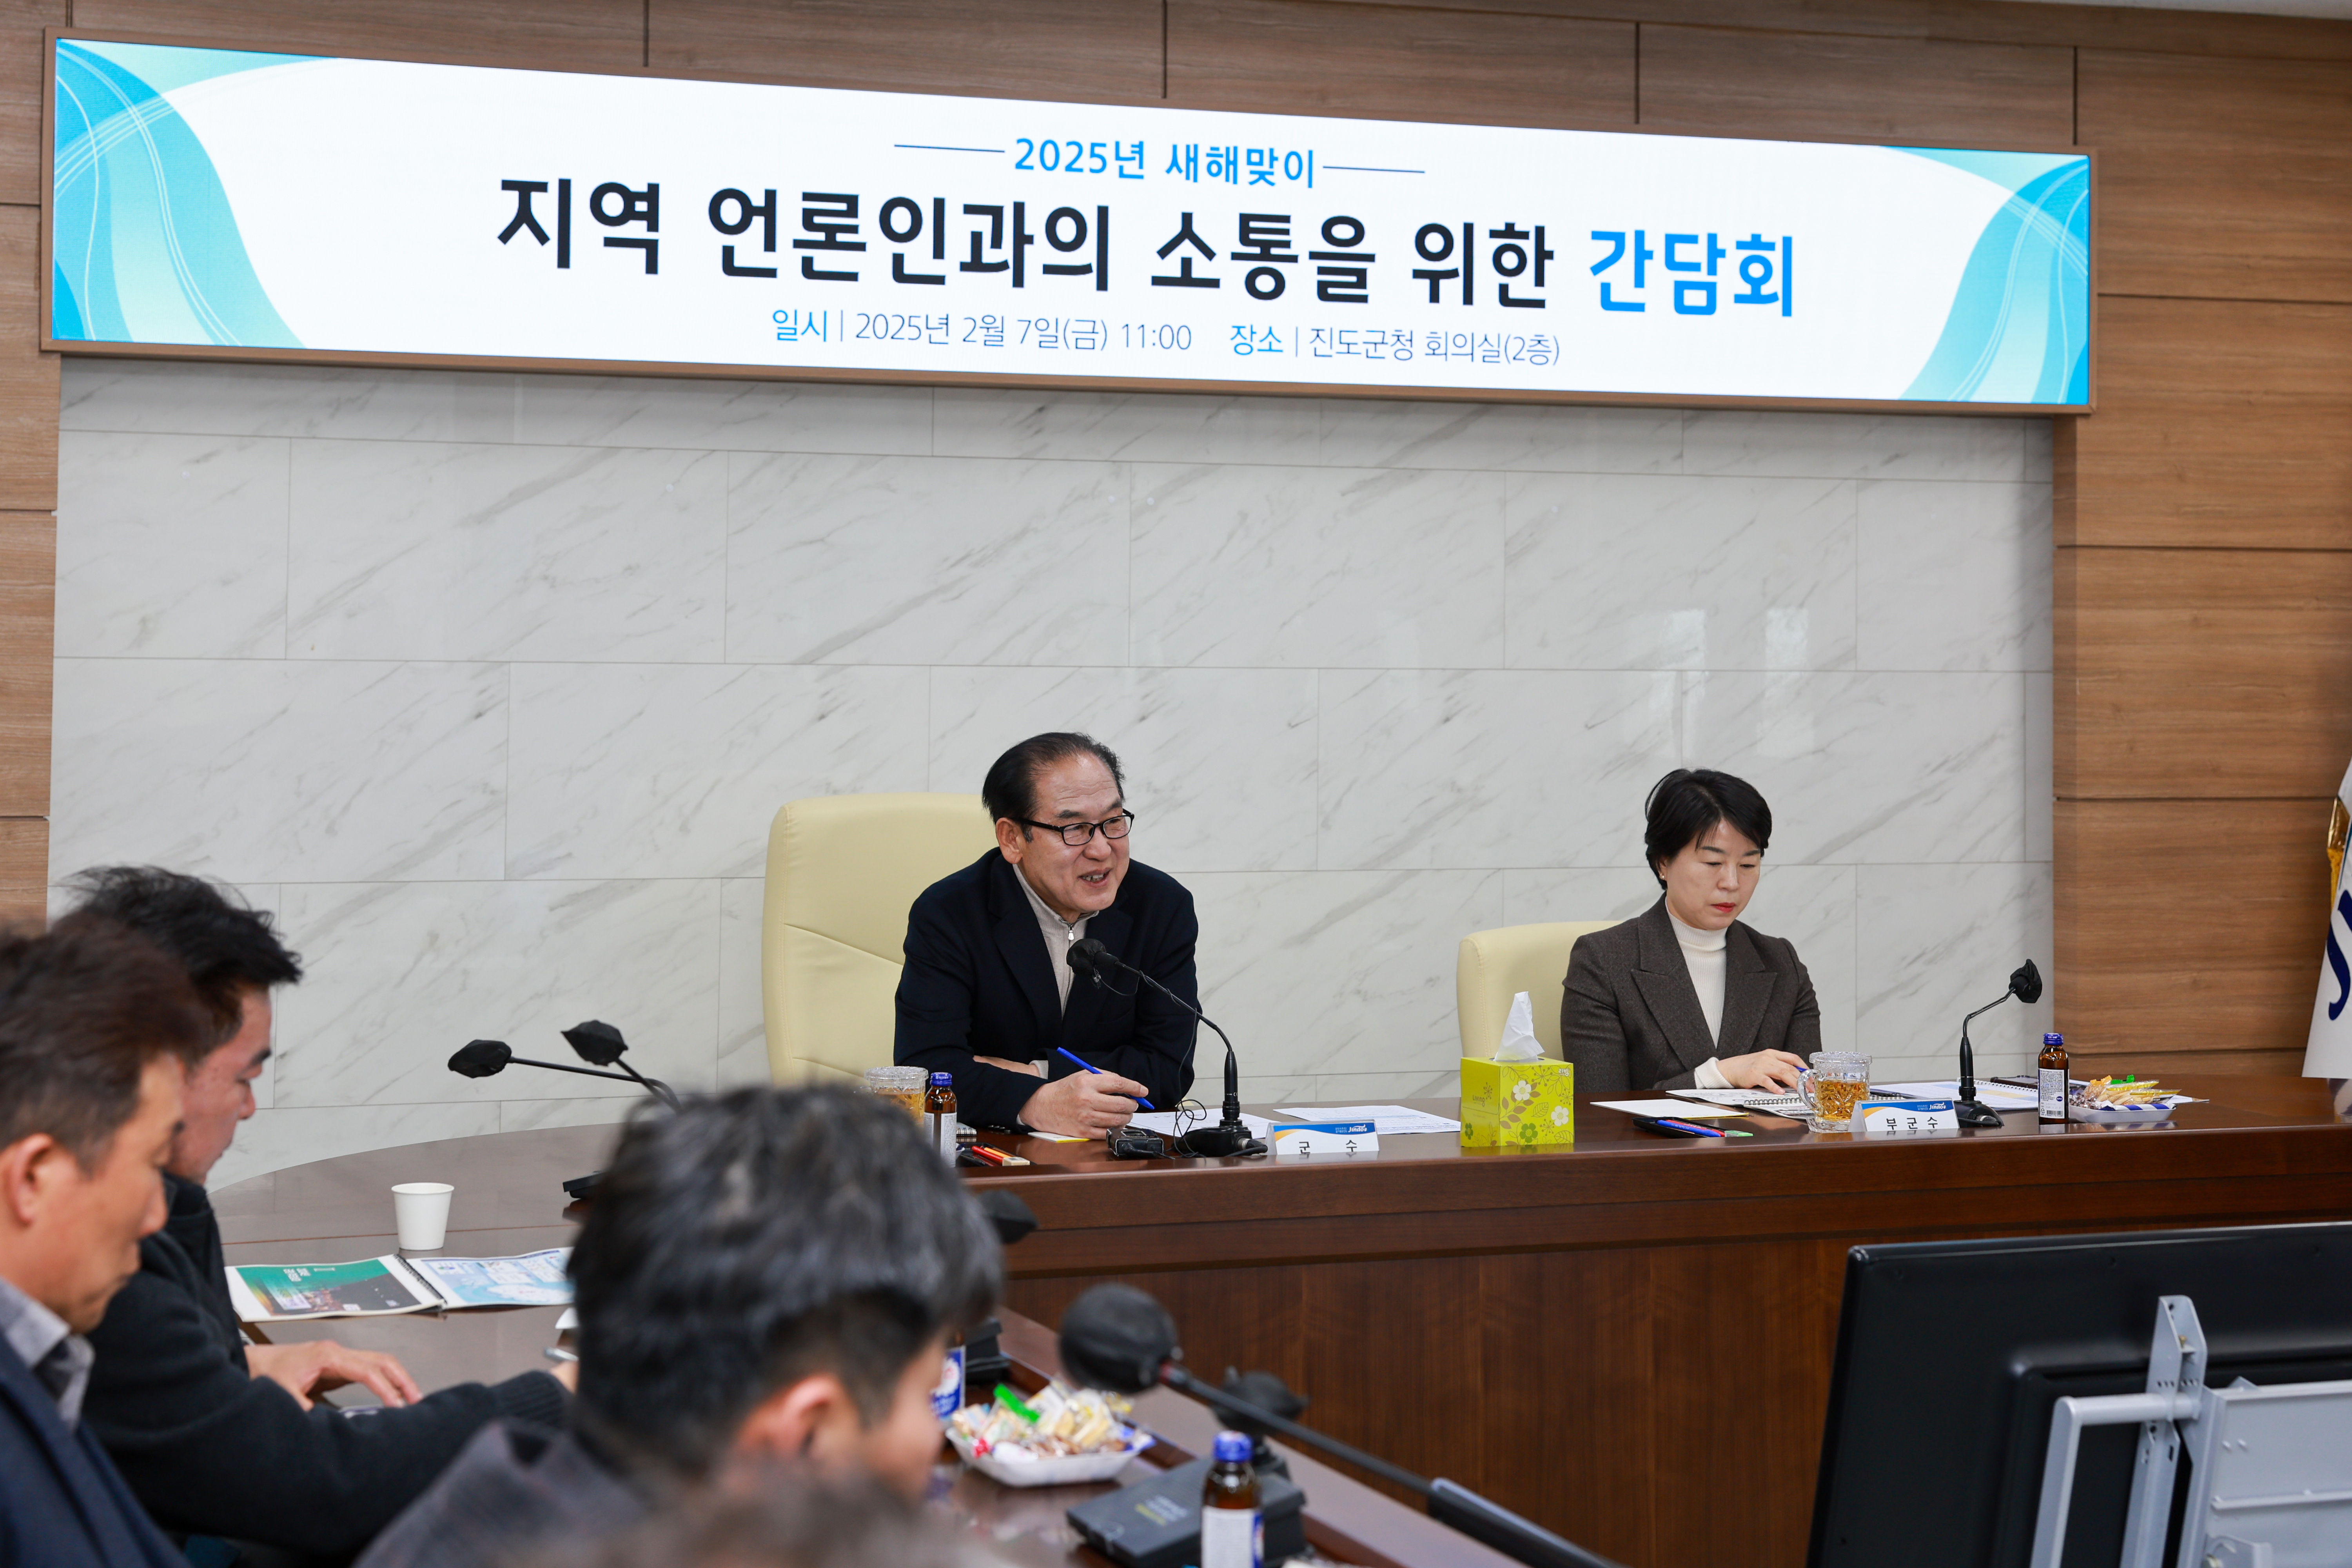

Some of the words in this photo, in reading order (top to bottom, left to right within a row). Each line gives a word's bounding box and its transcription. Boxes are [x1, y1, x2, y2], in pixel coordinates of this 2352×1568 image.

[1015, 138, 1144, 180] 2025년
[1165, 143, 1313, 188] 새해맞이
[497, 178, 659, 275] 지역
[708, 188, 1109, 292] 언론인과의
[1151, 212, 1376, 304] 소통을
[1412, 222, 1554, 309] 위한
[1590, 229, 1792, 317] 간담회
[773, 309, 827, 342] 일시
[856, 313, 949, 344] 2025년
[963, 315, 1004, 347] 2월
[1017, 318, 1107, 350] 7일(금)
[1122, 324, 1191, 350] 11:00
[1230, 324, 1283, 356] 장소
[1310, 327, 1412, 361] 진도군청
[1425, 332, 1559, 365] 회의실(2층)
